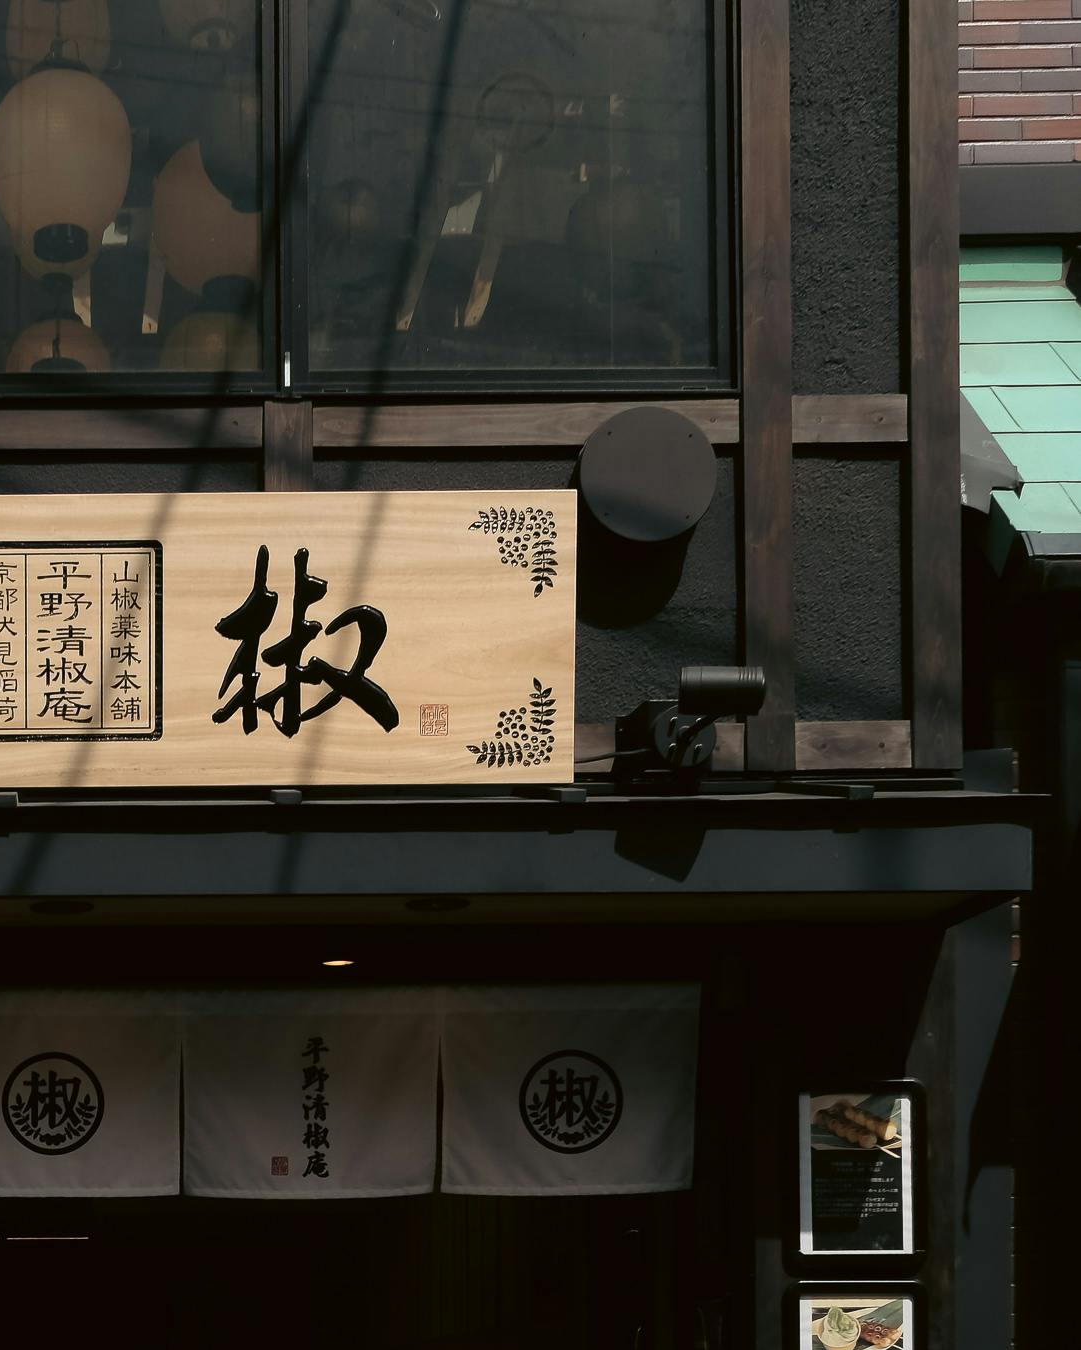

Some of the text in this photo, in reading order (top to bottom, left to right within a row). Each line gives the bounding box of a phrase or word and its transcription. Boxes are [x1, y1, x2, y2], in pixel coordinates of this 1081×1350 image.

[37, 562, 93, 723] 平野清椒庵
[110, 561, 142, 721] 山椒薬味本舗
[213, 545, 400, 738] 椒
[22, 1070, 81, 1129] 椒
[302, 1037, 330, 1178] 平野清椒庵
[540, 1068, 599, 1128] 椒
